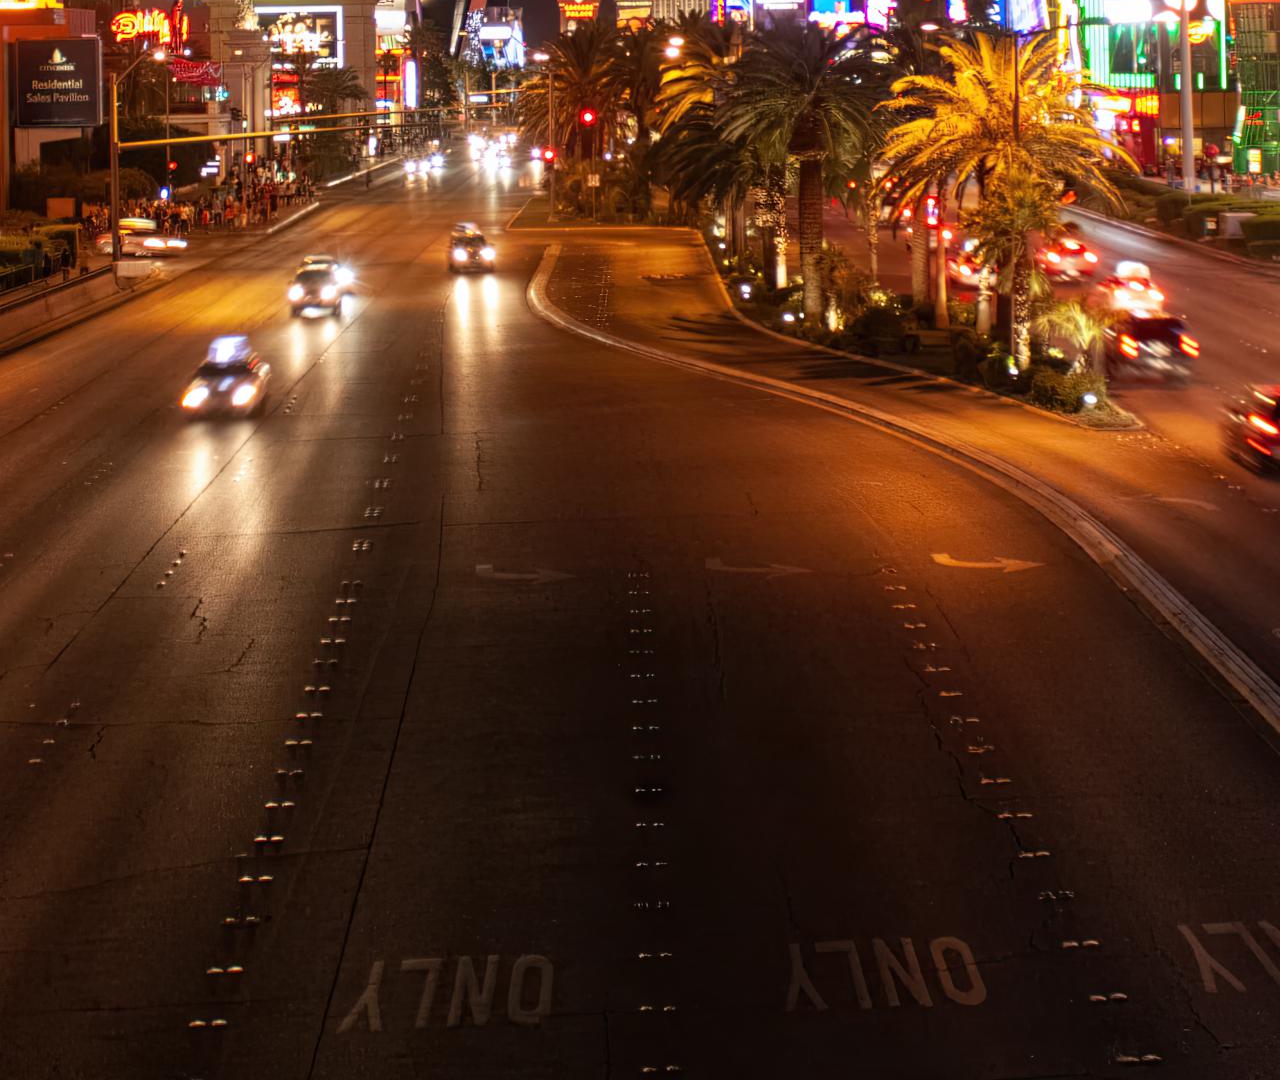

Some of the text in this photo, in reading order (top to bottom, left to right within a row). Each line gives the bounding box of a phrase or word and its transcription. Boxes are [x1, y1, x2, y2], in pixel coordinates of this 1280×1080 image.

[26, 92, 89, 104] Sales Pavilion
[31, 79, 83, 90] Residential
[336, 952, 556, 1034] ONLY
[784, 934, 988, 1012] ONLY
